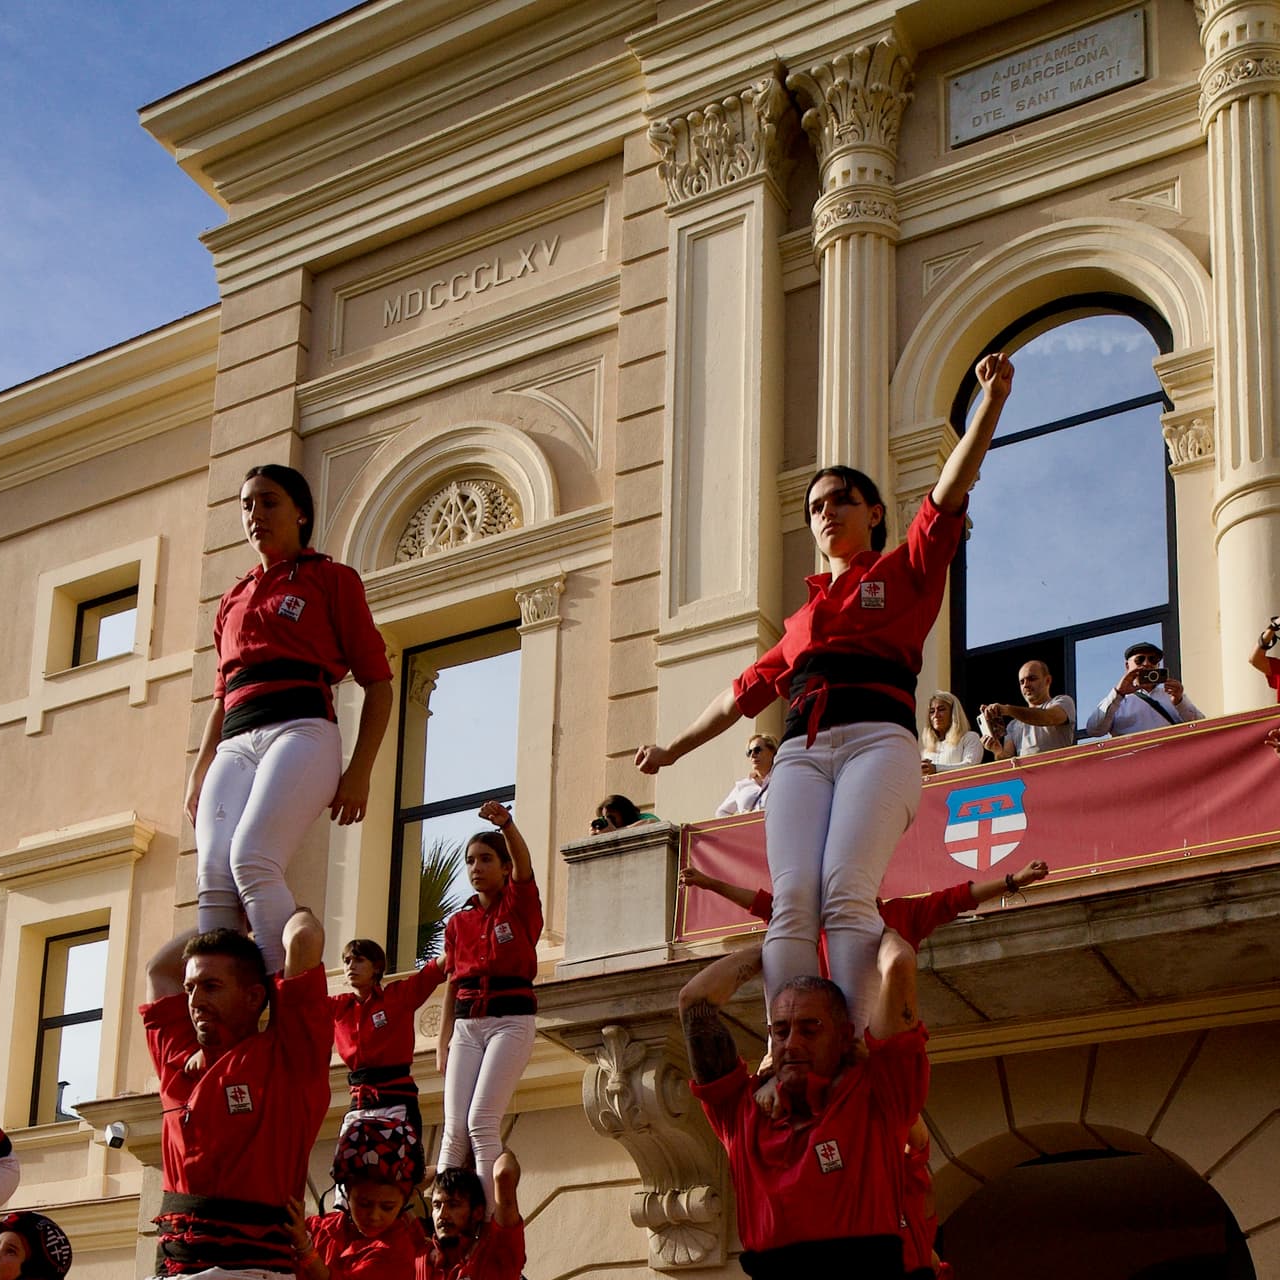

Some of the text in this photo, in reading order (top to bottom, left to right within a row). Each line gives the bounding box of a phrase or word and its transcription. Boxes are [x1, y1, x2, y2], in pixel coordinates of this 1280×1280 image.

[980, 45, 1110, 104] DE BARCELONA
[991, 33, 1099, 84] AJUNTAMENT
[971, 107, 1006, 128] DTE.
[1015, 86, 1059, 113] SANT
[383, 234, 562, 329] MDCCCLXV
